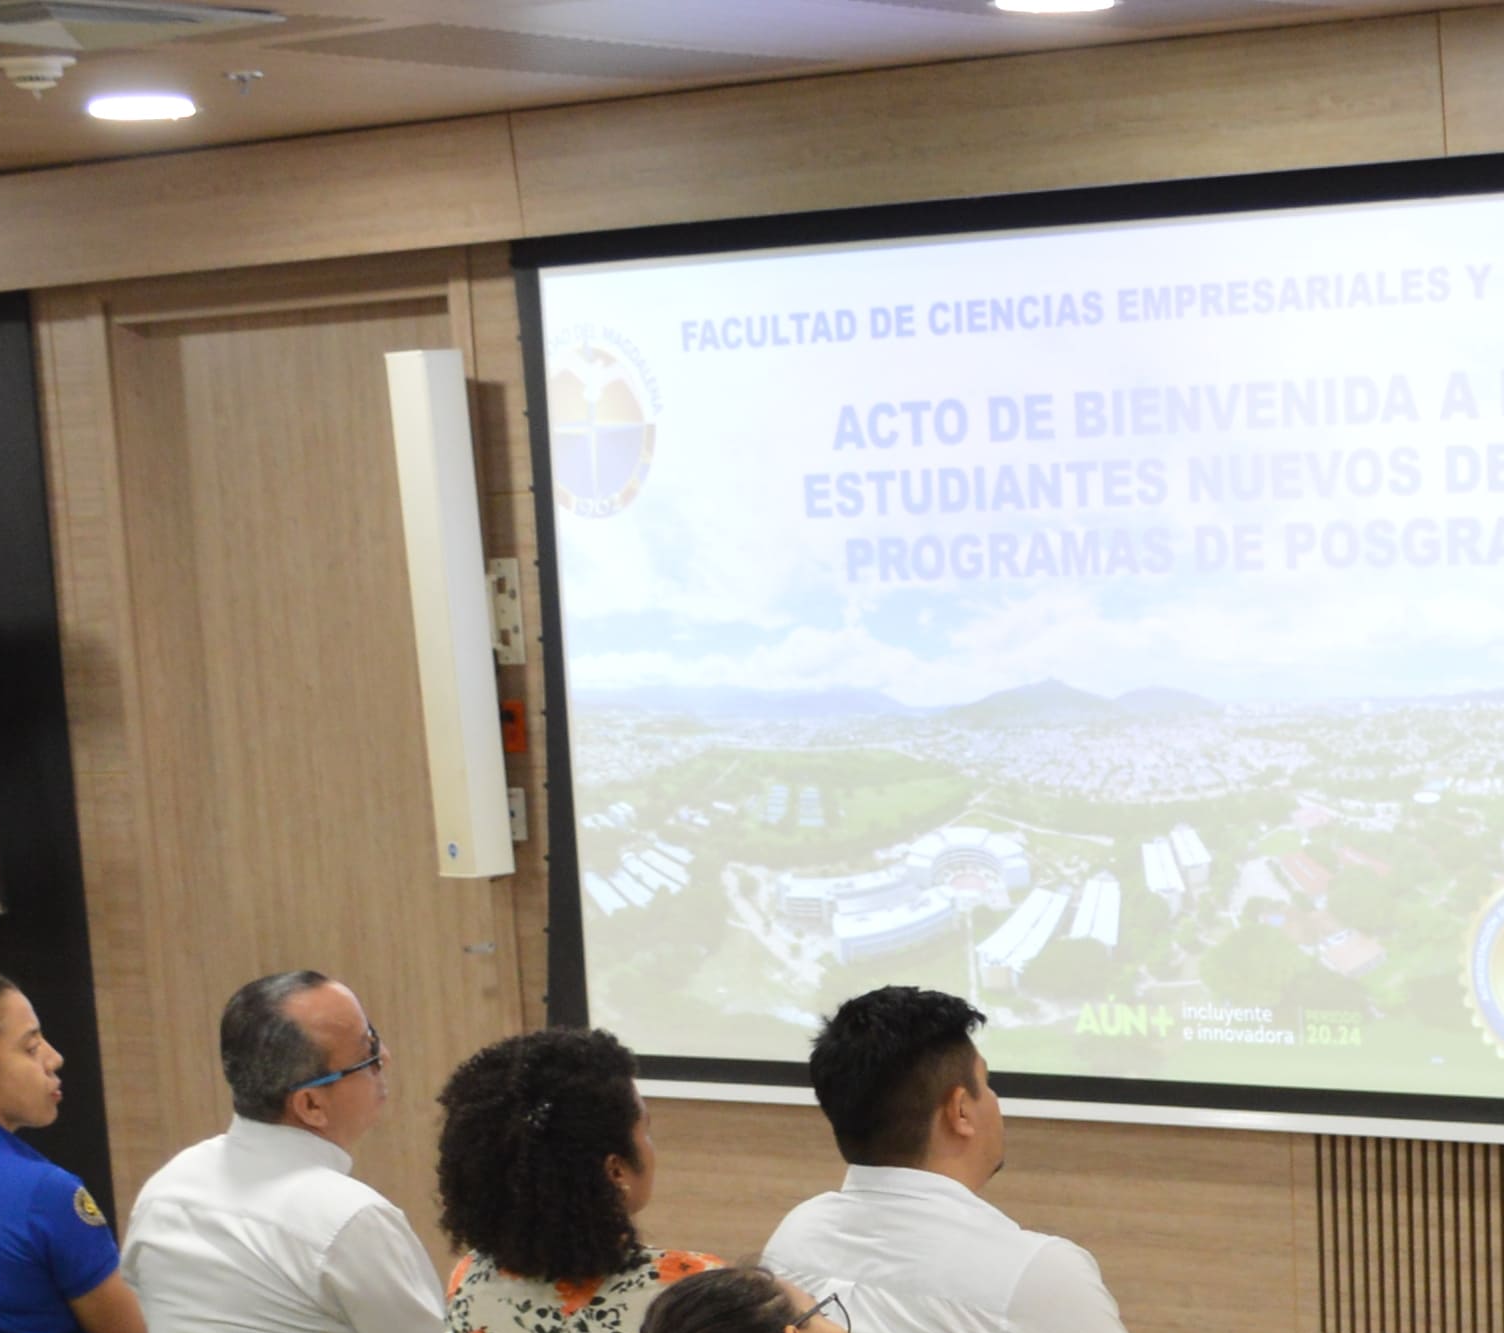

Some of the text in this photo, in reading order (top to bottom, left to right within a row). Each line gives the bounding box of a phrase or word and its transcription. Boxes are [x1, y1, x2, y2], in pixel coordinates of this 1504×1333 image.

[680, 307, 857, 353] FACULTAD
[869, 302, 916, 339] DE
[928, 290, 1104, 335] CIENCIAS
[1117, 264, 1452, 324] EMPRESARIALES
[1465, 263, 1499, 300] Y
[832, 396, 968, 452] ACTO
[986, 393, 1056, 443] DE
[1073, 373, 1419, 440] BIENVENIDA
[1440, 369, 1481, 421] A
[803, 456, 1168, 520] ESTUDIANTES
[1187, 446, 1423, 504] NUEVOS
[845, 521, 1173, 583] PROGRAMAS
[1193, 520, 1264, 572] DE
[1183, 1001, 1273, 1026] incluyente
[1183, 1023, 1295, 1045] e innovadora
